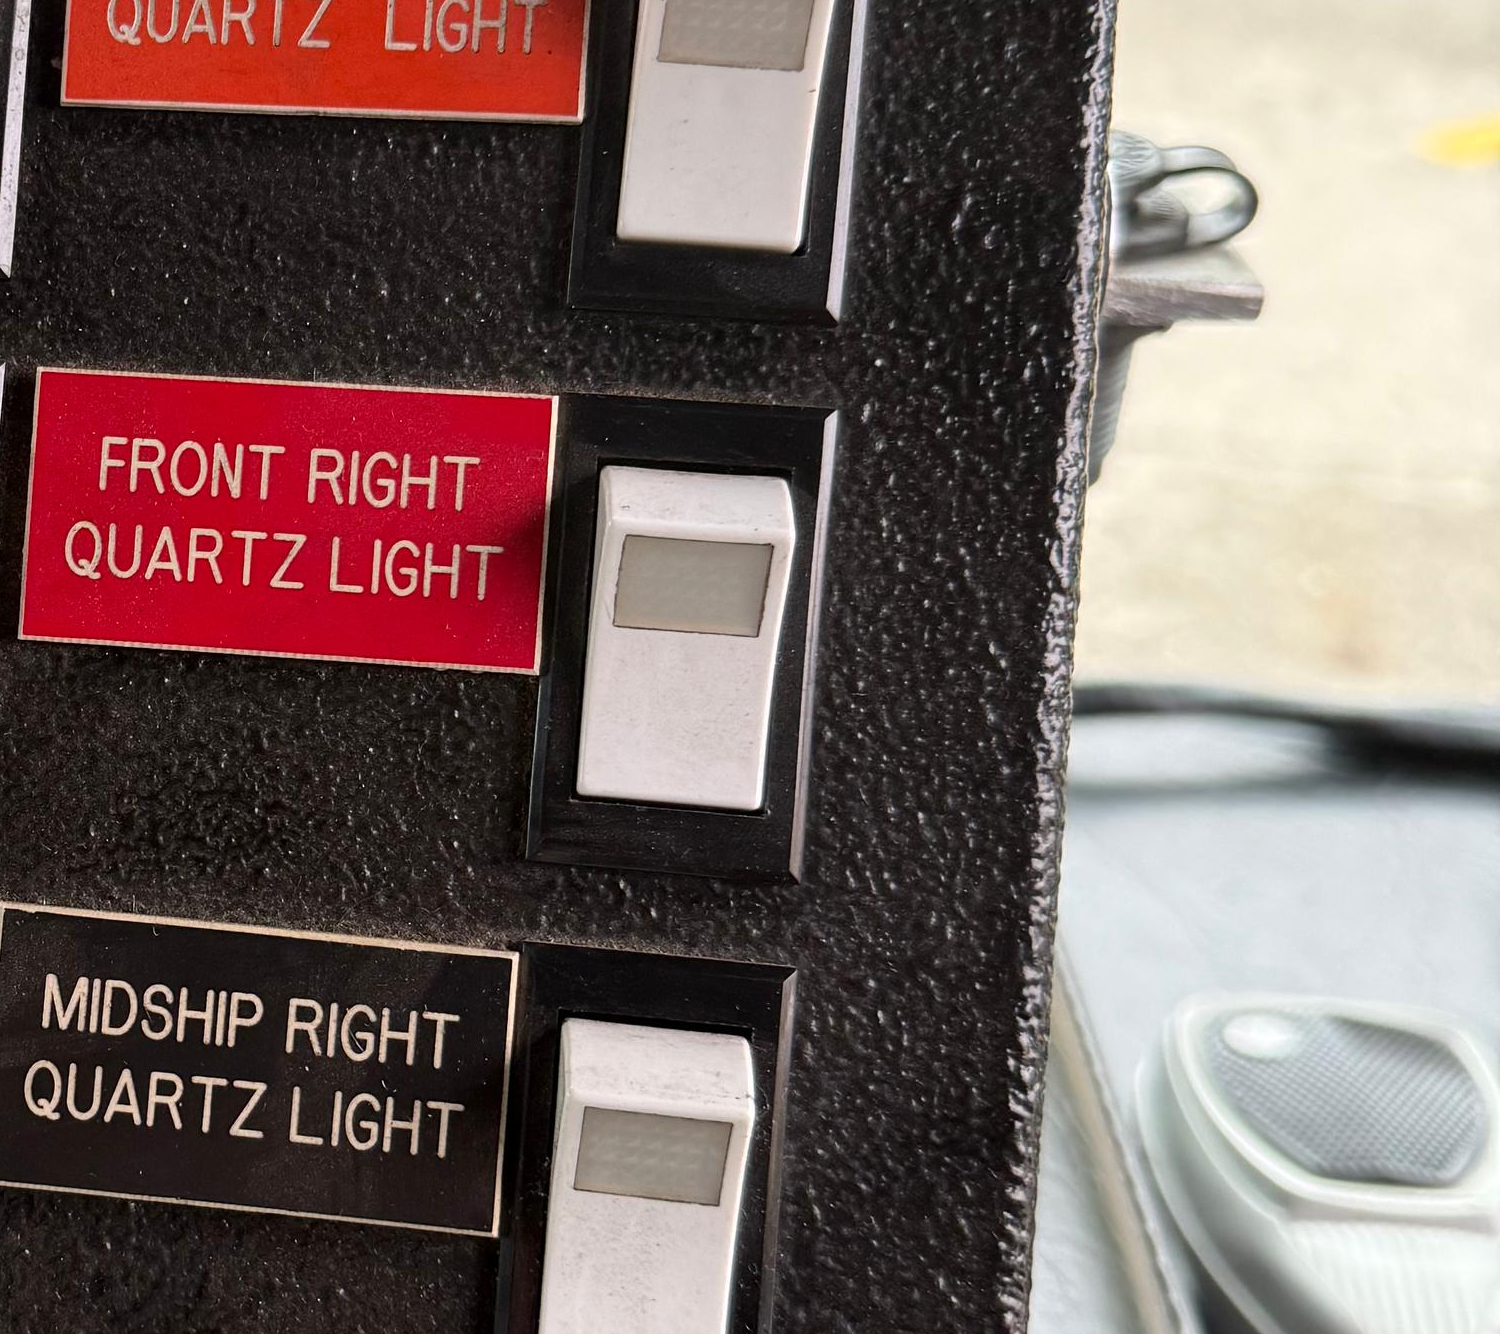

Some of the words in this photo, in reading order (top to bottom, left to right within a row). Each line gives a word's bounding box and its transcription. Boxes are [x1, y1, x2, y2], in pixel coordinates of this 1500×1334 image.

[99, 435, 285, 500] FRONT
[307, 448, 481, 512] RIGHT
[64, 520, 307, 590] QUARTZ
[329, 536, 504, 601] LIGHT
[42, 972, 264, 1048] MIDSHIP
[285, 998, 461, 1069] RIGHT
[23, 1059, 268, 1139] QUARTZ
[289, 1086, 465, 1159] LIGHT
